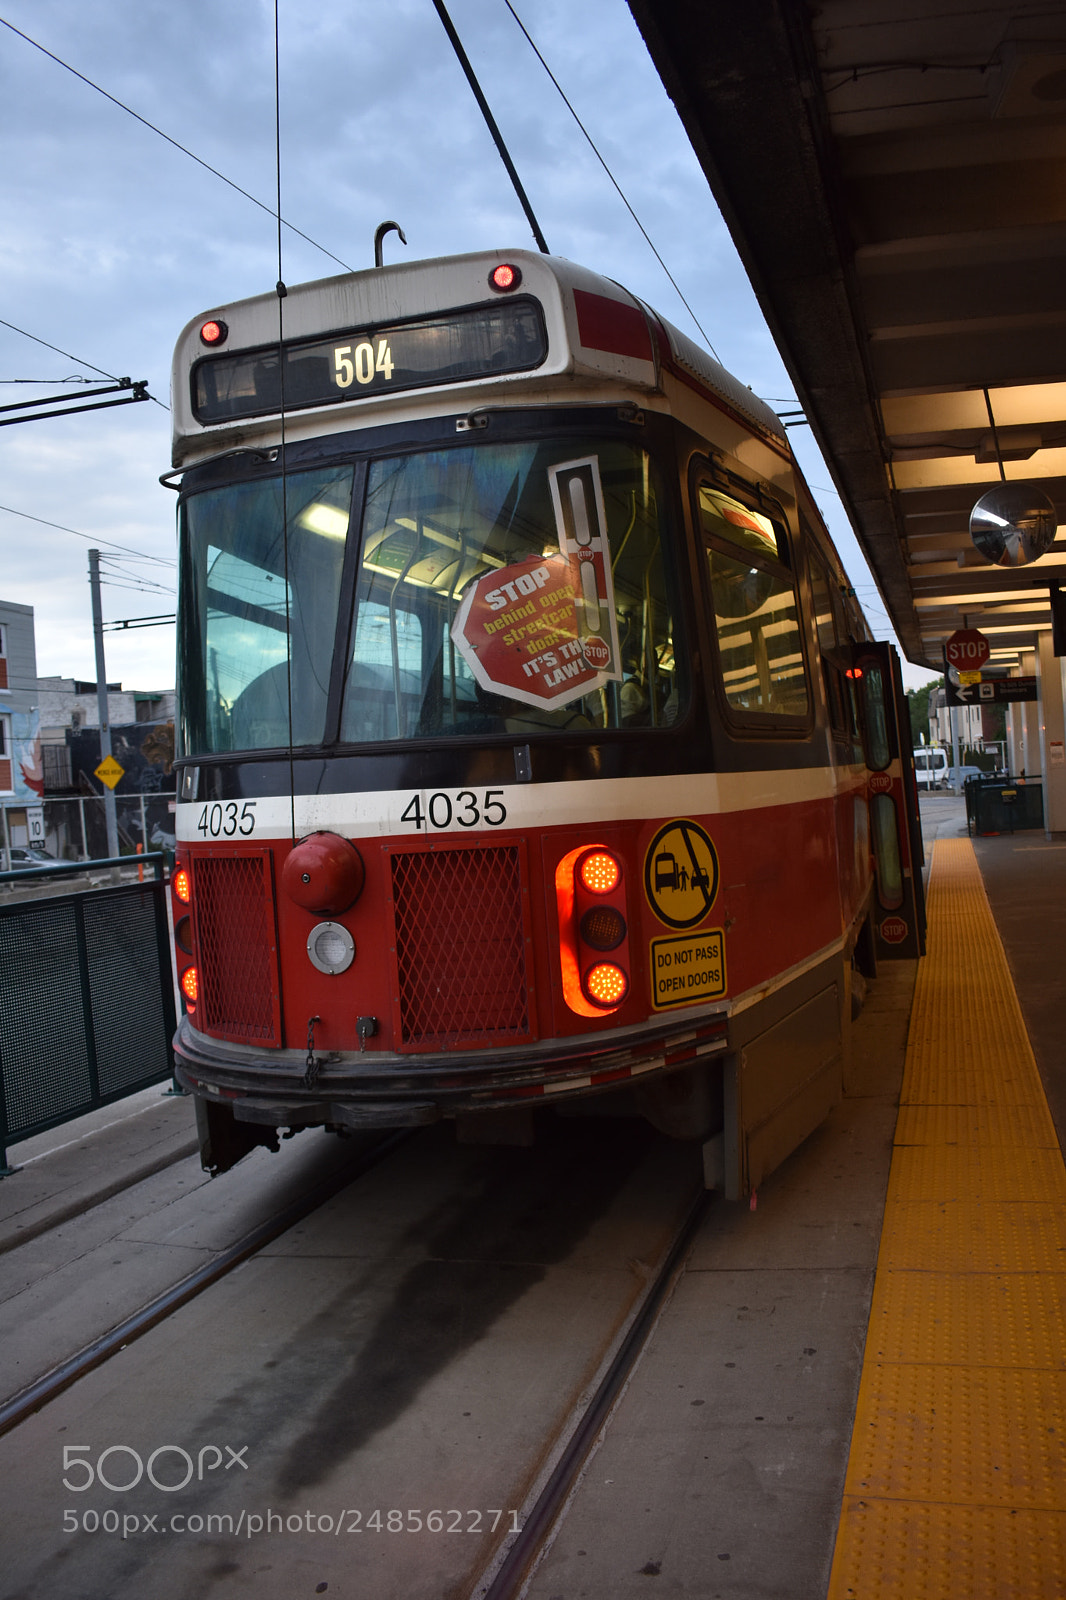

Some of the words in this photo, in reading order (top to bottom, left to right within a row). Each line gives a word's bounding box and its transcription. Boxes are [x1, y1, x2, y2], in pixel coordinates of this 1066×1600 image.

[334, 339, 395, 389] 504
[484, 566, 550, 611] STOP
[483, 600, 537, 635] behind
[539, 585, 575, 609] open
[502, 604, 574, 646] streetcar
[526, 627, 569, 655] doors
[585, 642, 608, 659] STOP
[949, 641, 987, 660] STOP
[522, 651, 558, 677] IT'S
[543, 658, 587, 688] LAW!
[870, 776, 889, 787] STOP
[197, 802, 257, 837] 4035
[400, 790, 508, 830] 4035
[31, 821, 41, 836] 10
[884, 924, 904, 937] STOP
[657, 952, 672, 968] DO
[674, 949, 694, 965] NOT
[696, 945, 719, 961] PASS
[658, 975, 686, 993] OPEN
[687, 969, 721, 988] DOORS
